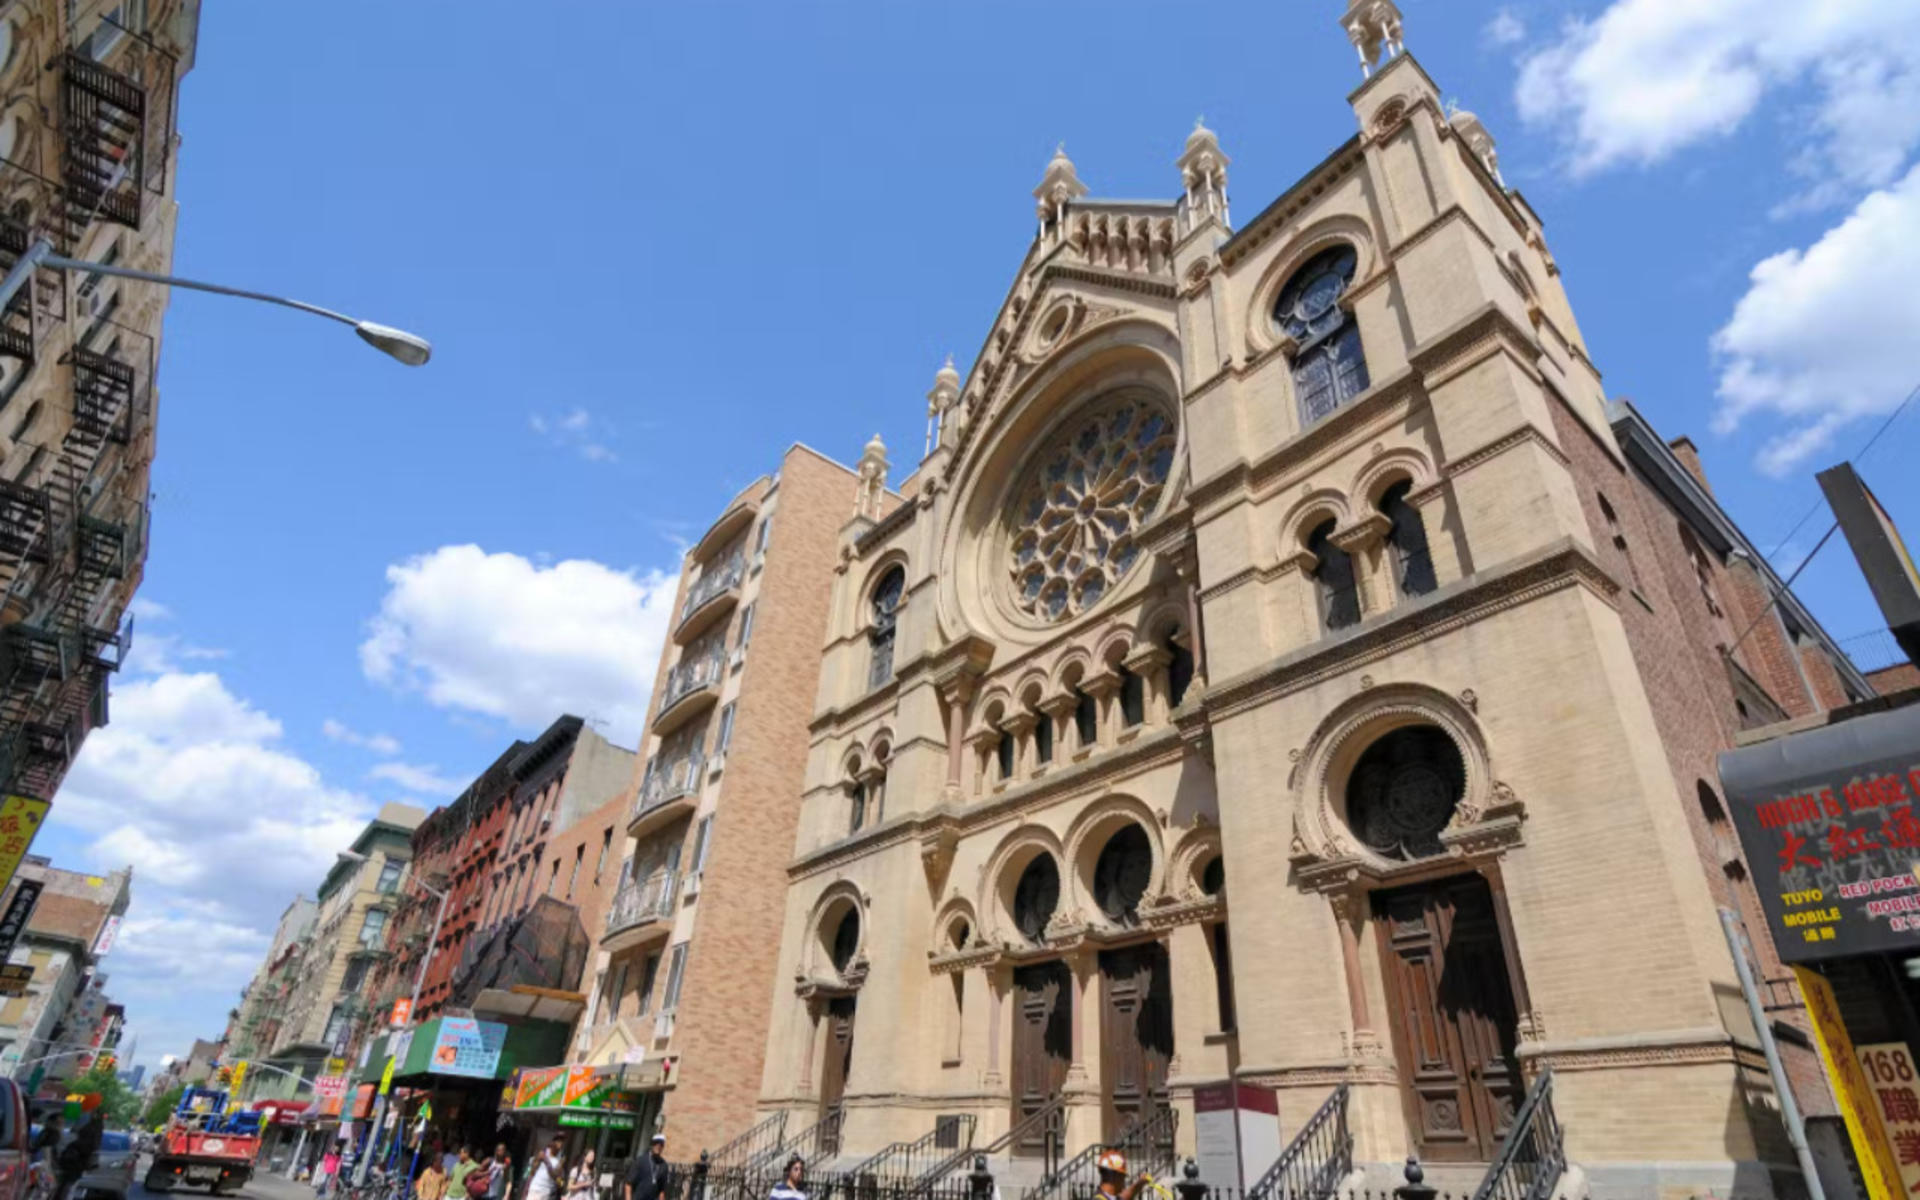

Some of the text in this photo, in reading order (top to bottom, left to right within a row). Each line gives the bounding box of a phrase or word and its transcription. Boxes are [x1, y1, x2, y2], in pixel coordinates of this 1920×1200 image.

[1781, 888, 1823, 906] TUYO
[1839, 881, 1871, 898] RED
[1783, 907, 1842, 927] MOBILE
[1862, 1050, 1913, 1084] 168
